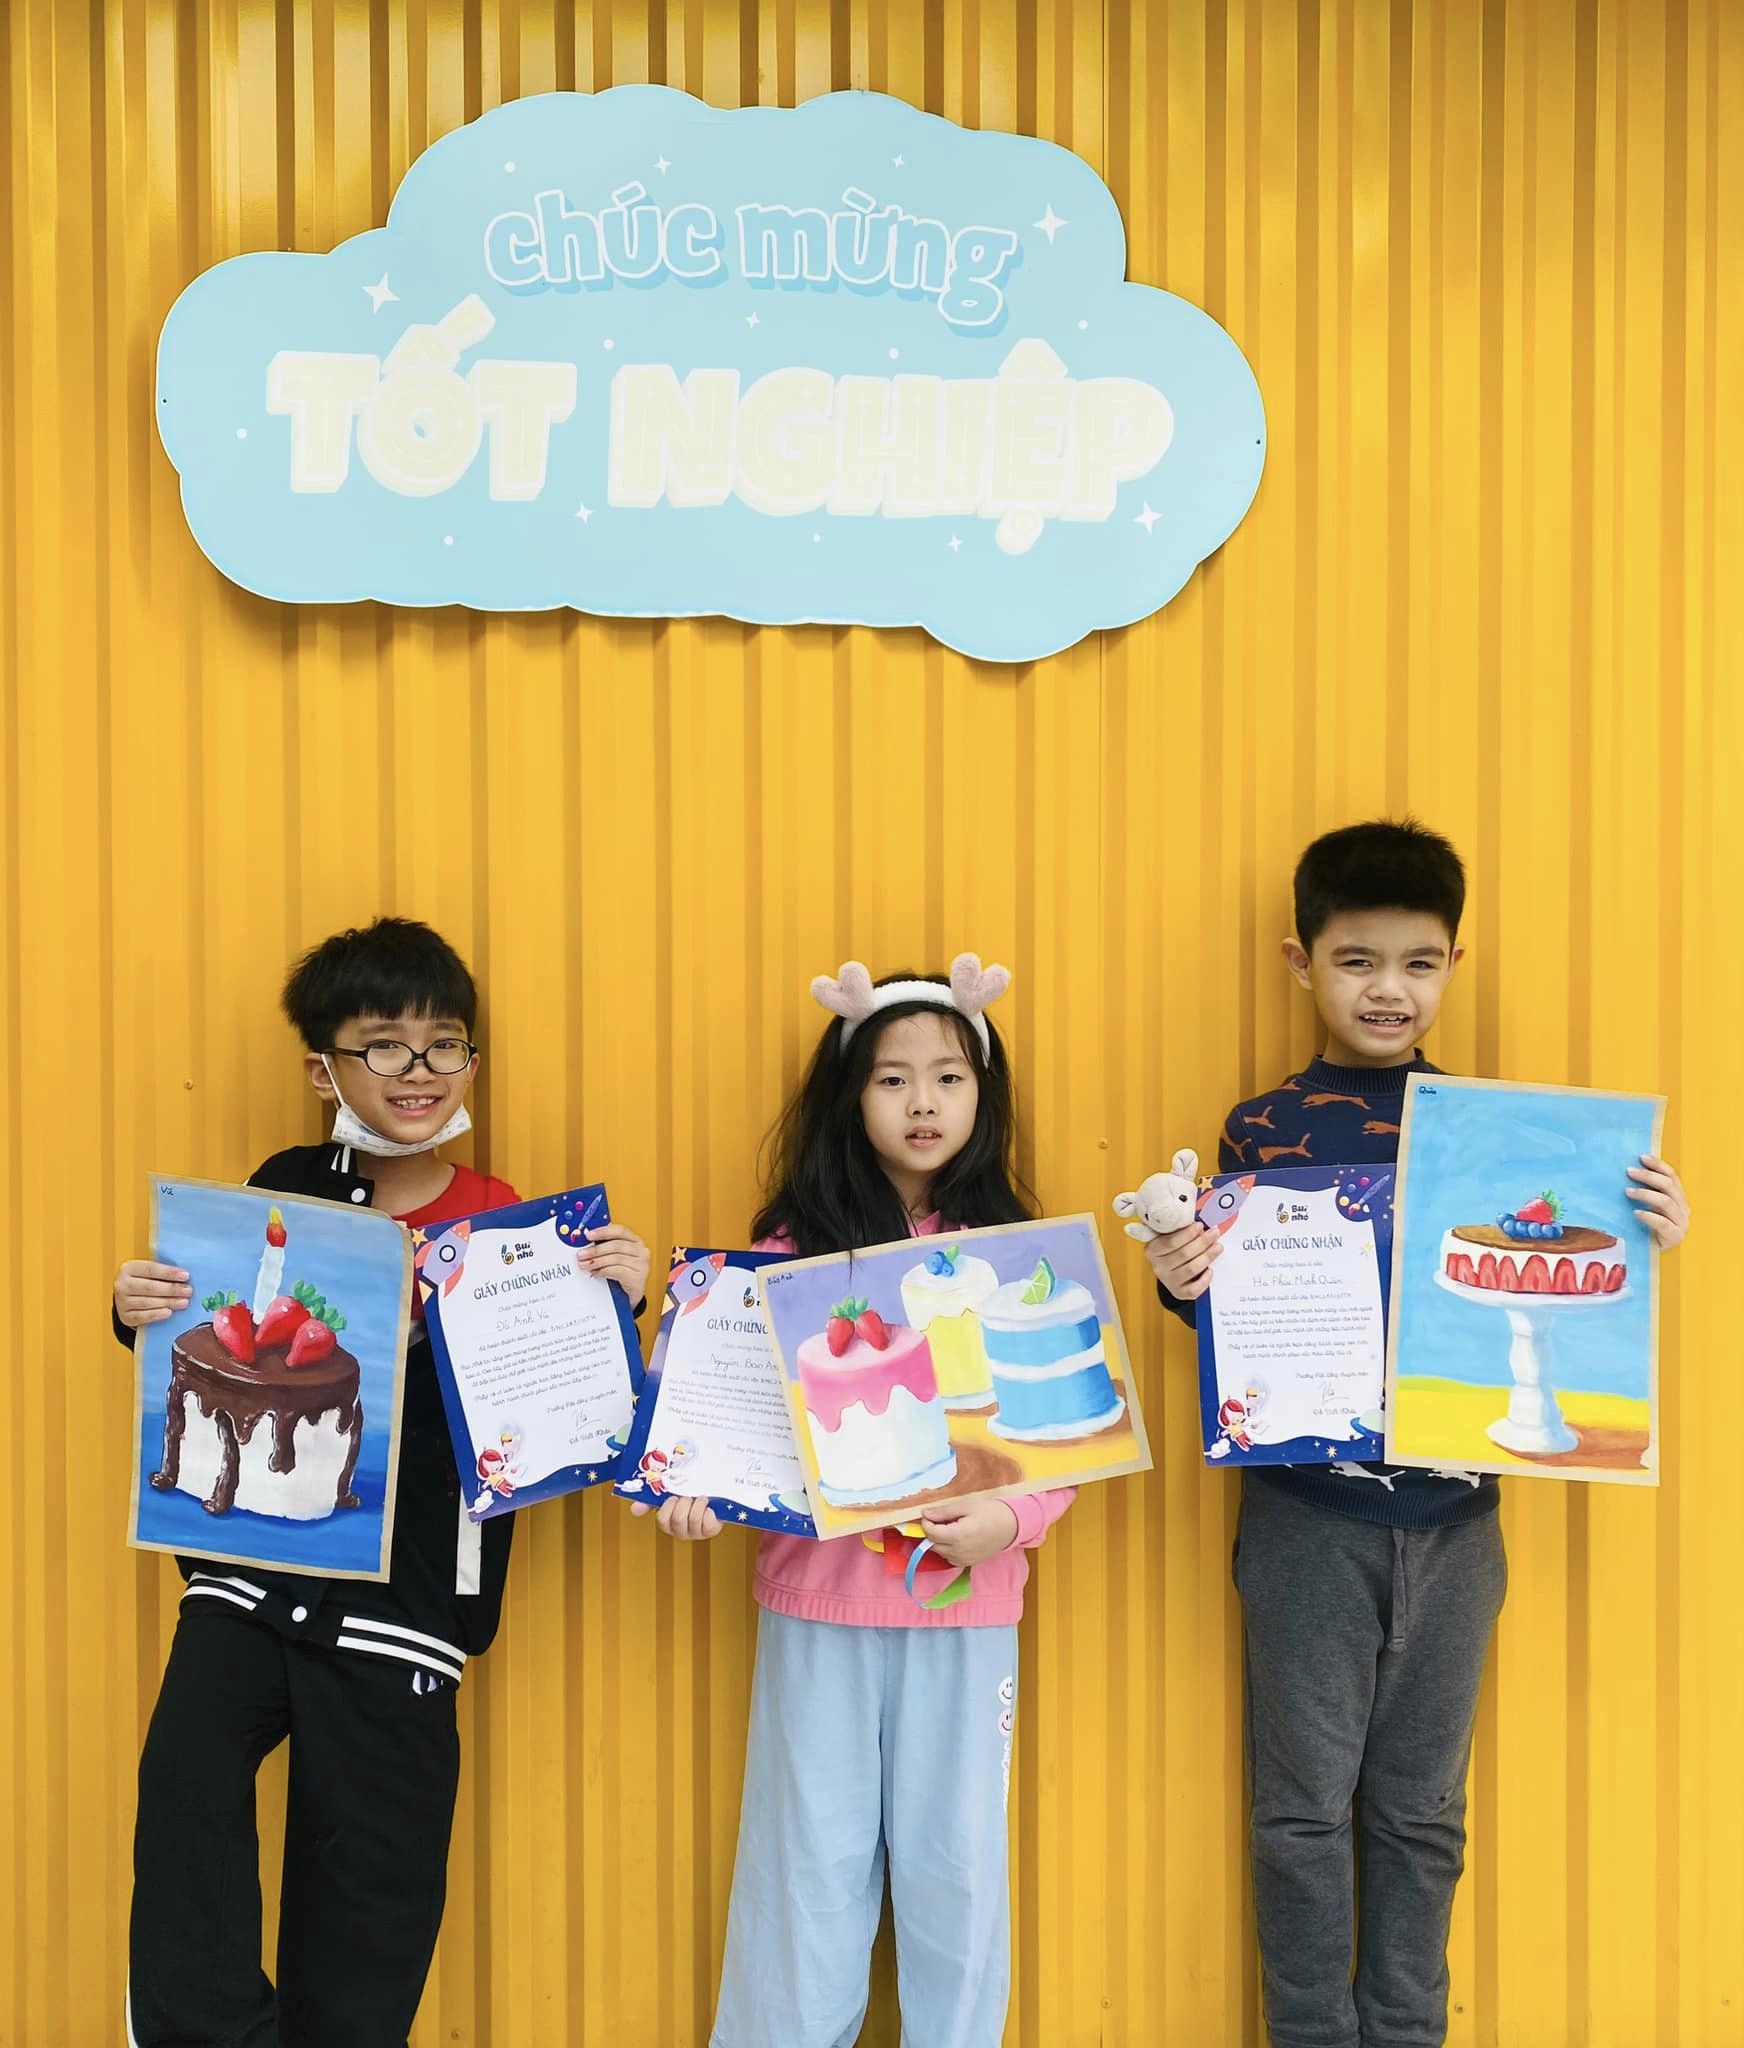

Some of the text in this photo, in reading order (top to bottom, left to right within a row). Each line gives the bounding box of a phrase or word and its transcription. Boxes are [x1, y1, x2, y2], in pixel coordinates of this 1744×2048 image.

[484, 181, 1018, 326] chúc mừng
[266, 293, 1174, 555] TỐT NGHIỆP
[1242, 1234, 1343, 1251] GIẤY CHỨNG NHẬN
[473, 1263, 572, 1300] GIẤY CHỨNG NHẬN
[707, 1315, 731, 1332] GIẤY
